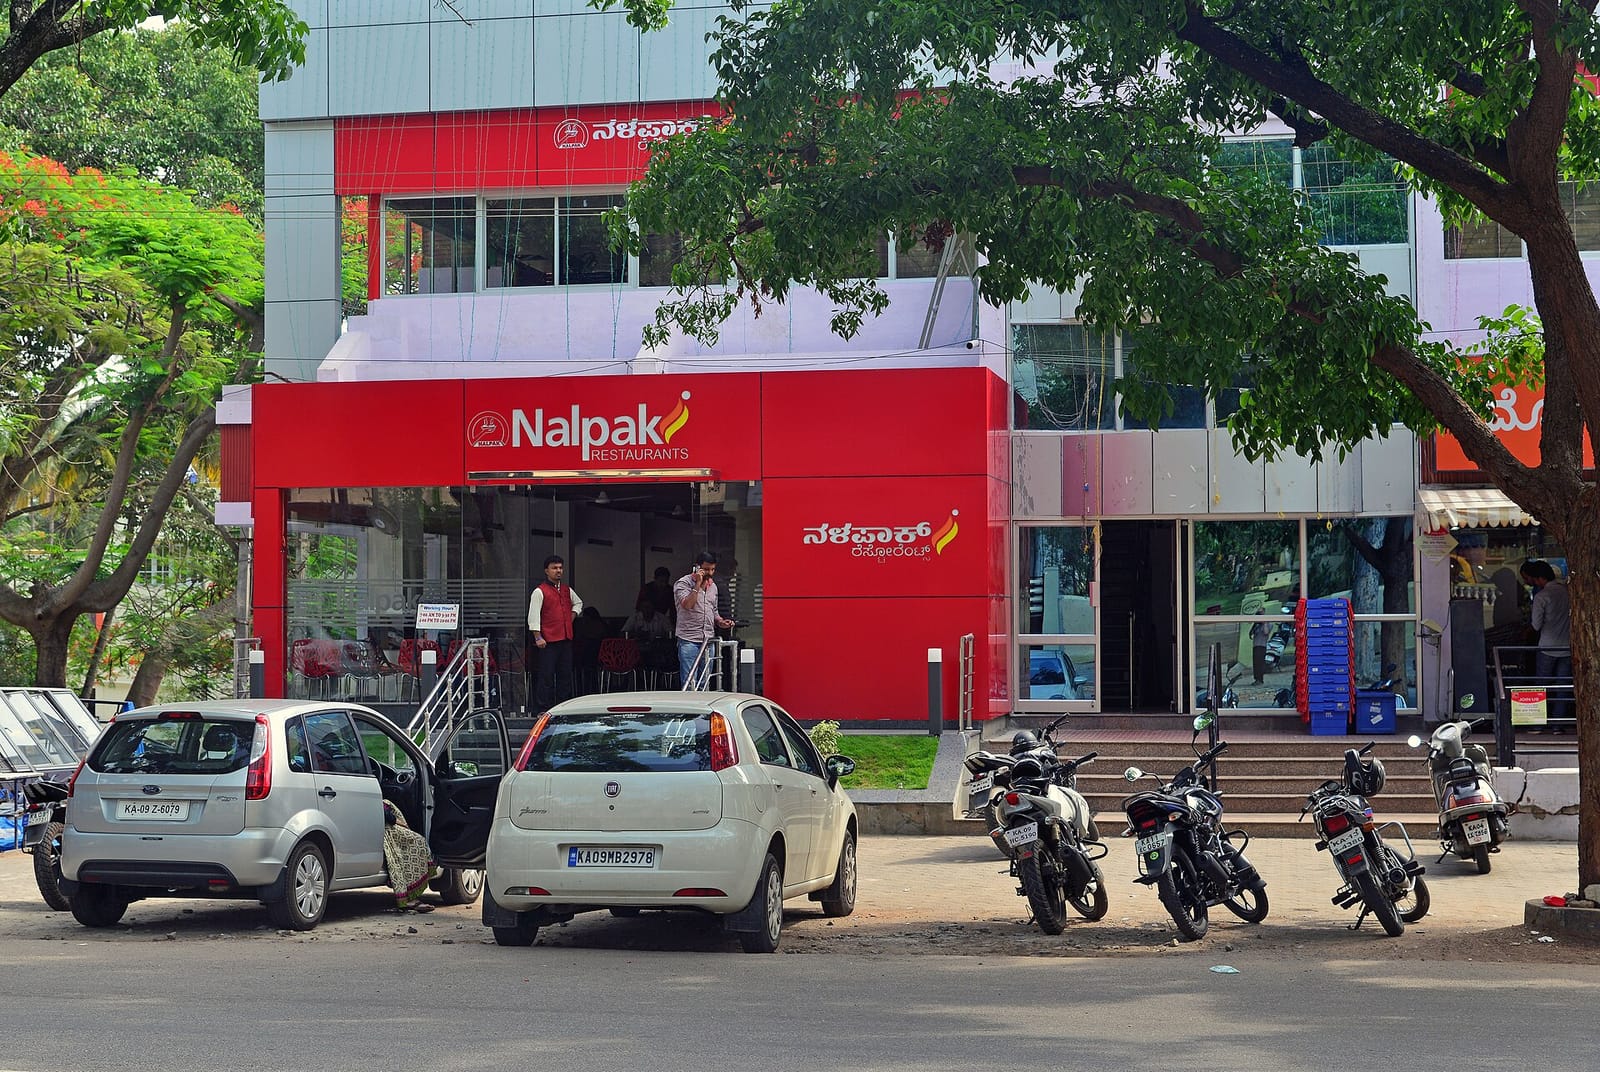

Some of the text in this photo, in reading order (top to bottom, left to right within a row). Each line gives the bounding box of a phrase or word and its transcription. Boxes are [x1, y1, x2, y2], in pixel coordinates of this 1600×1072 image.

[511, 403, 665, 462] Nalpak
[591, 448, 689, 461] RESTAURANTS
[802, 521, 932, 545] ನಳಪಾಕ್
[124, 804, 180, 814] KA-09 Z-6079
[577, 851, 653, 864] KA09MB2978
